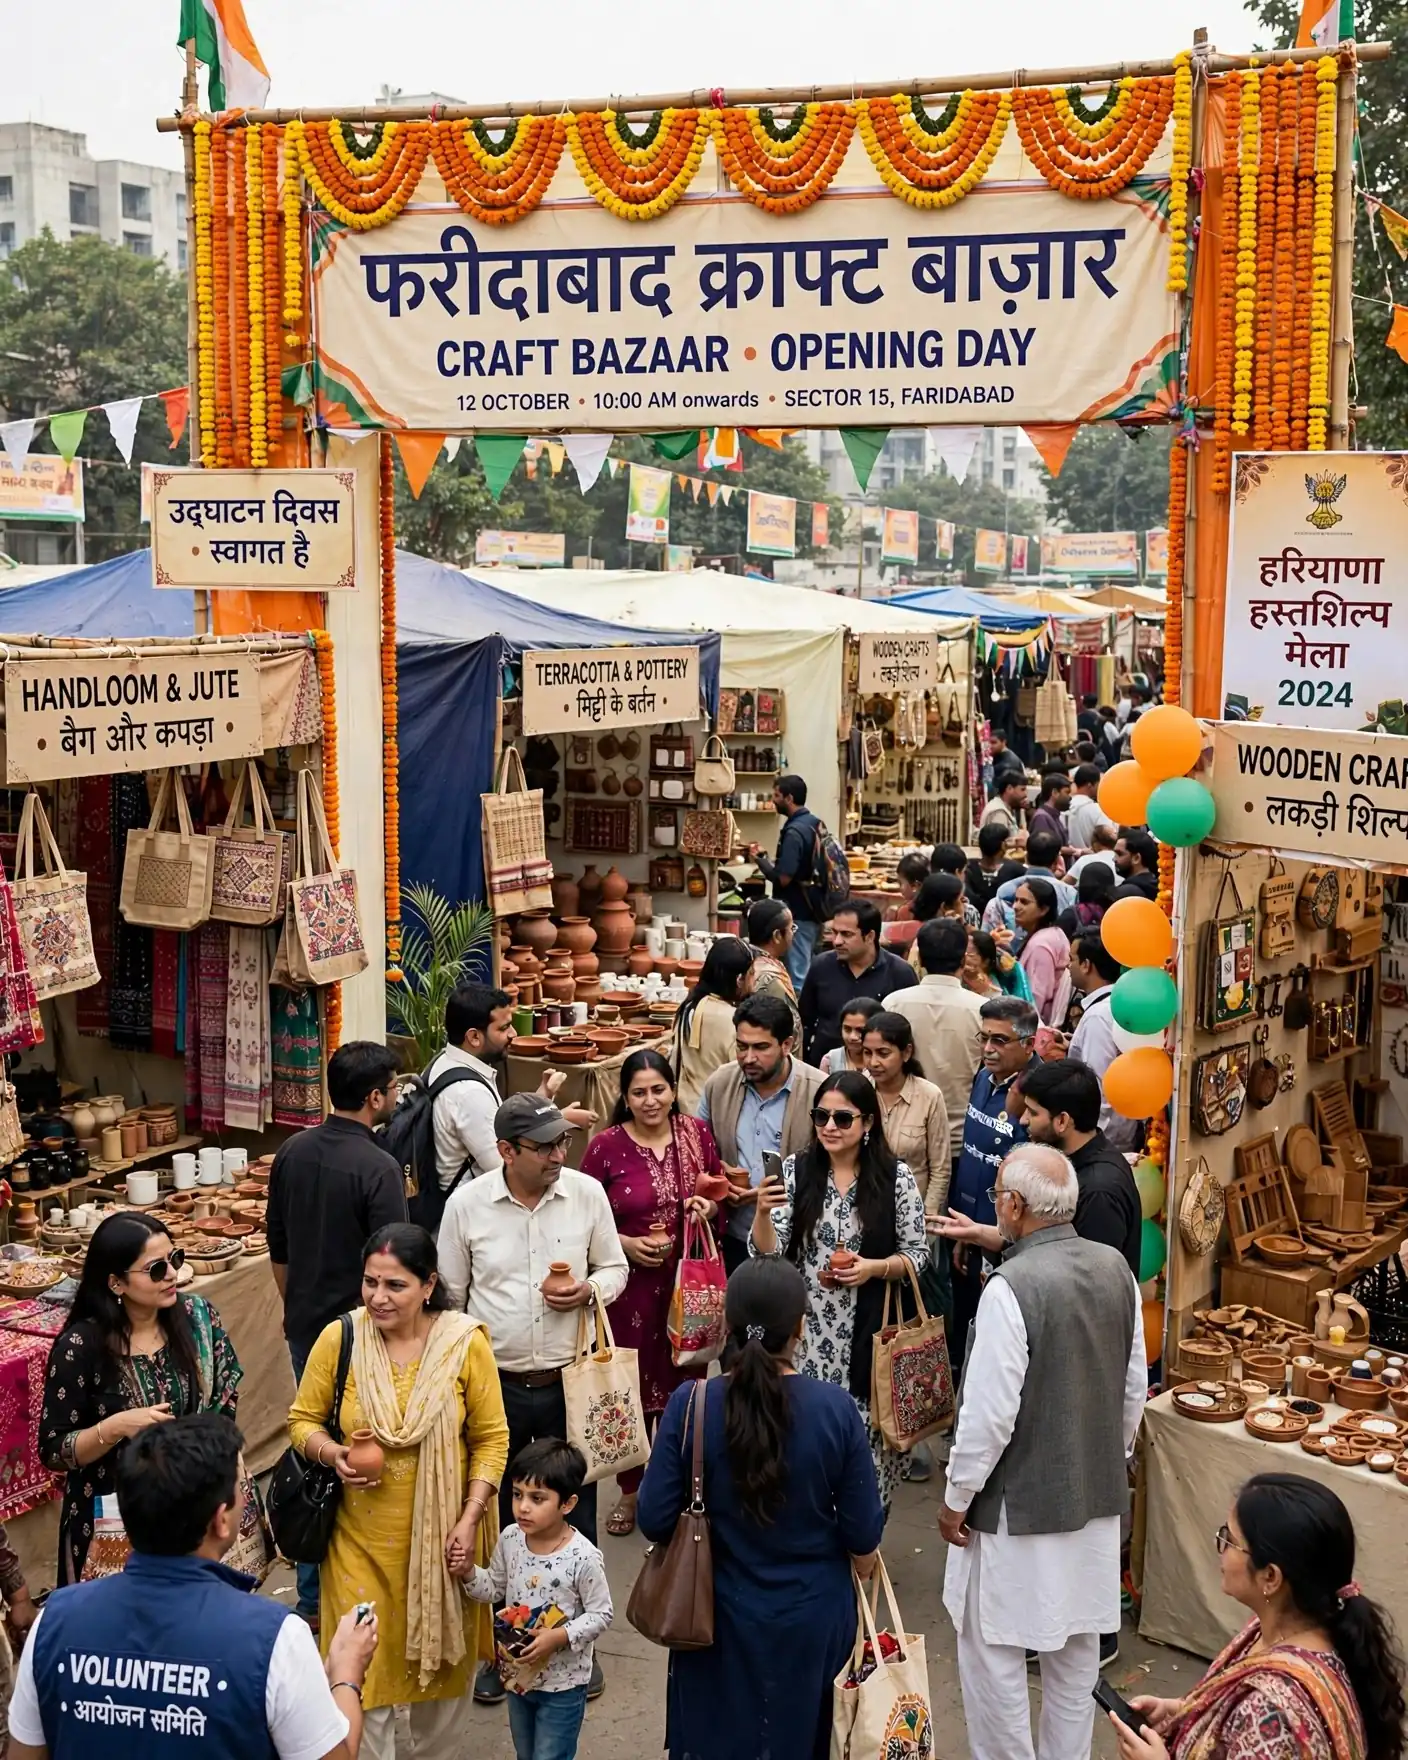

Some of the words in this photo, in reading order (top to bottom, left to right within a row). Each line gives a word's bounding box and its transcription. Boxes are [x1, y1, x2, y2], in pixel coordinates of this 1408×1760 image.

[360, 225, 675, 321] फरीदाबाद
[695, 239, 888, 312] क्राफ्ट
[908, 229, 1125, 314] बाज़ार
[438, 339, 559, 377] CRAFT
[573, 336, 729, 375] BAZAAR
[771, 330, 943, 371] OPENING
[958, 328, 1036, 367] DAY
[458, 395, 476, 411] 12
[482, 393, 569, 411] OCTOBER
[594, 392, 641, 409] 10:00
[648, 392, 676, 409] AM
[683, 390, 759, 408] onwards
[785, 389, 861, 407] SECTOR
[869, 389, 894, 409] 15,
[902, 386, 1014, 405] FARIDABAD
[273, 490, 340, 527] दिवस
[209, 540, 285, 565] स्वागत
[293, 530, 310, 569] है
[1259, 547, 1385, 586] हरियाणा
[1249, 590, 1392, 629] हस्तशिल्प
[873, 641, 902, 658] WOODEN
[904, 641, 930, 657] CRAFTS
[1284, 632, 1349, 669] मेला
[22, 674, 158, 711] HANDLOOM
[166, 673, 182, 702] &
[189, 669, 240, 701] JUTE
[536, 660, 620, 686] TERRACOTTA
[623, 660, 633, 682] &
[637, 658, 688, 681] POTTERY
[576, 687, 606, 722] मिट्टी
[610, 687, 623, 715] के
[627, 685, 656, 714] बर्तन
[1278, 679, 1353, 708] 2024
[60, 716, 96, 756] बैग
[105, 711, 147, 751] और
[154, 717, 214, 751] कपड़ा
[1238, 744, 1341, 782] WOODEN
[1266, 791, 1339, 837] लकड़ी
[71, 1653, 210, 1698] VOLUNTEER
[74, 1696, 145, 1728] आयोजन
[150, 1704, 207, 1736] समिति
